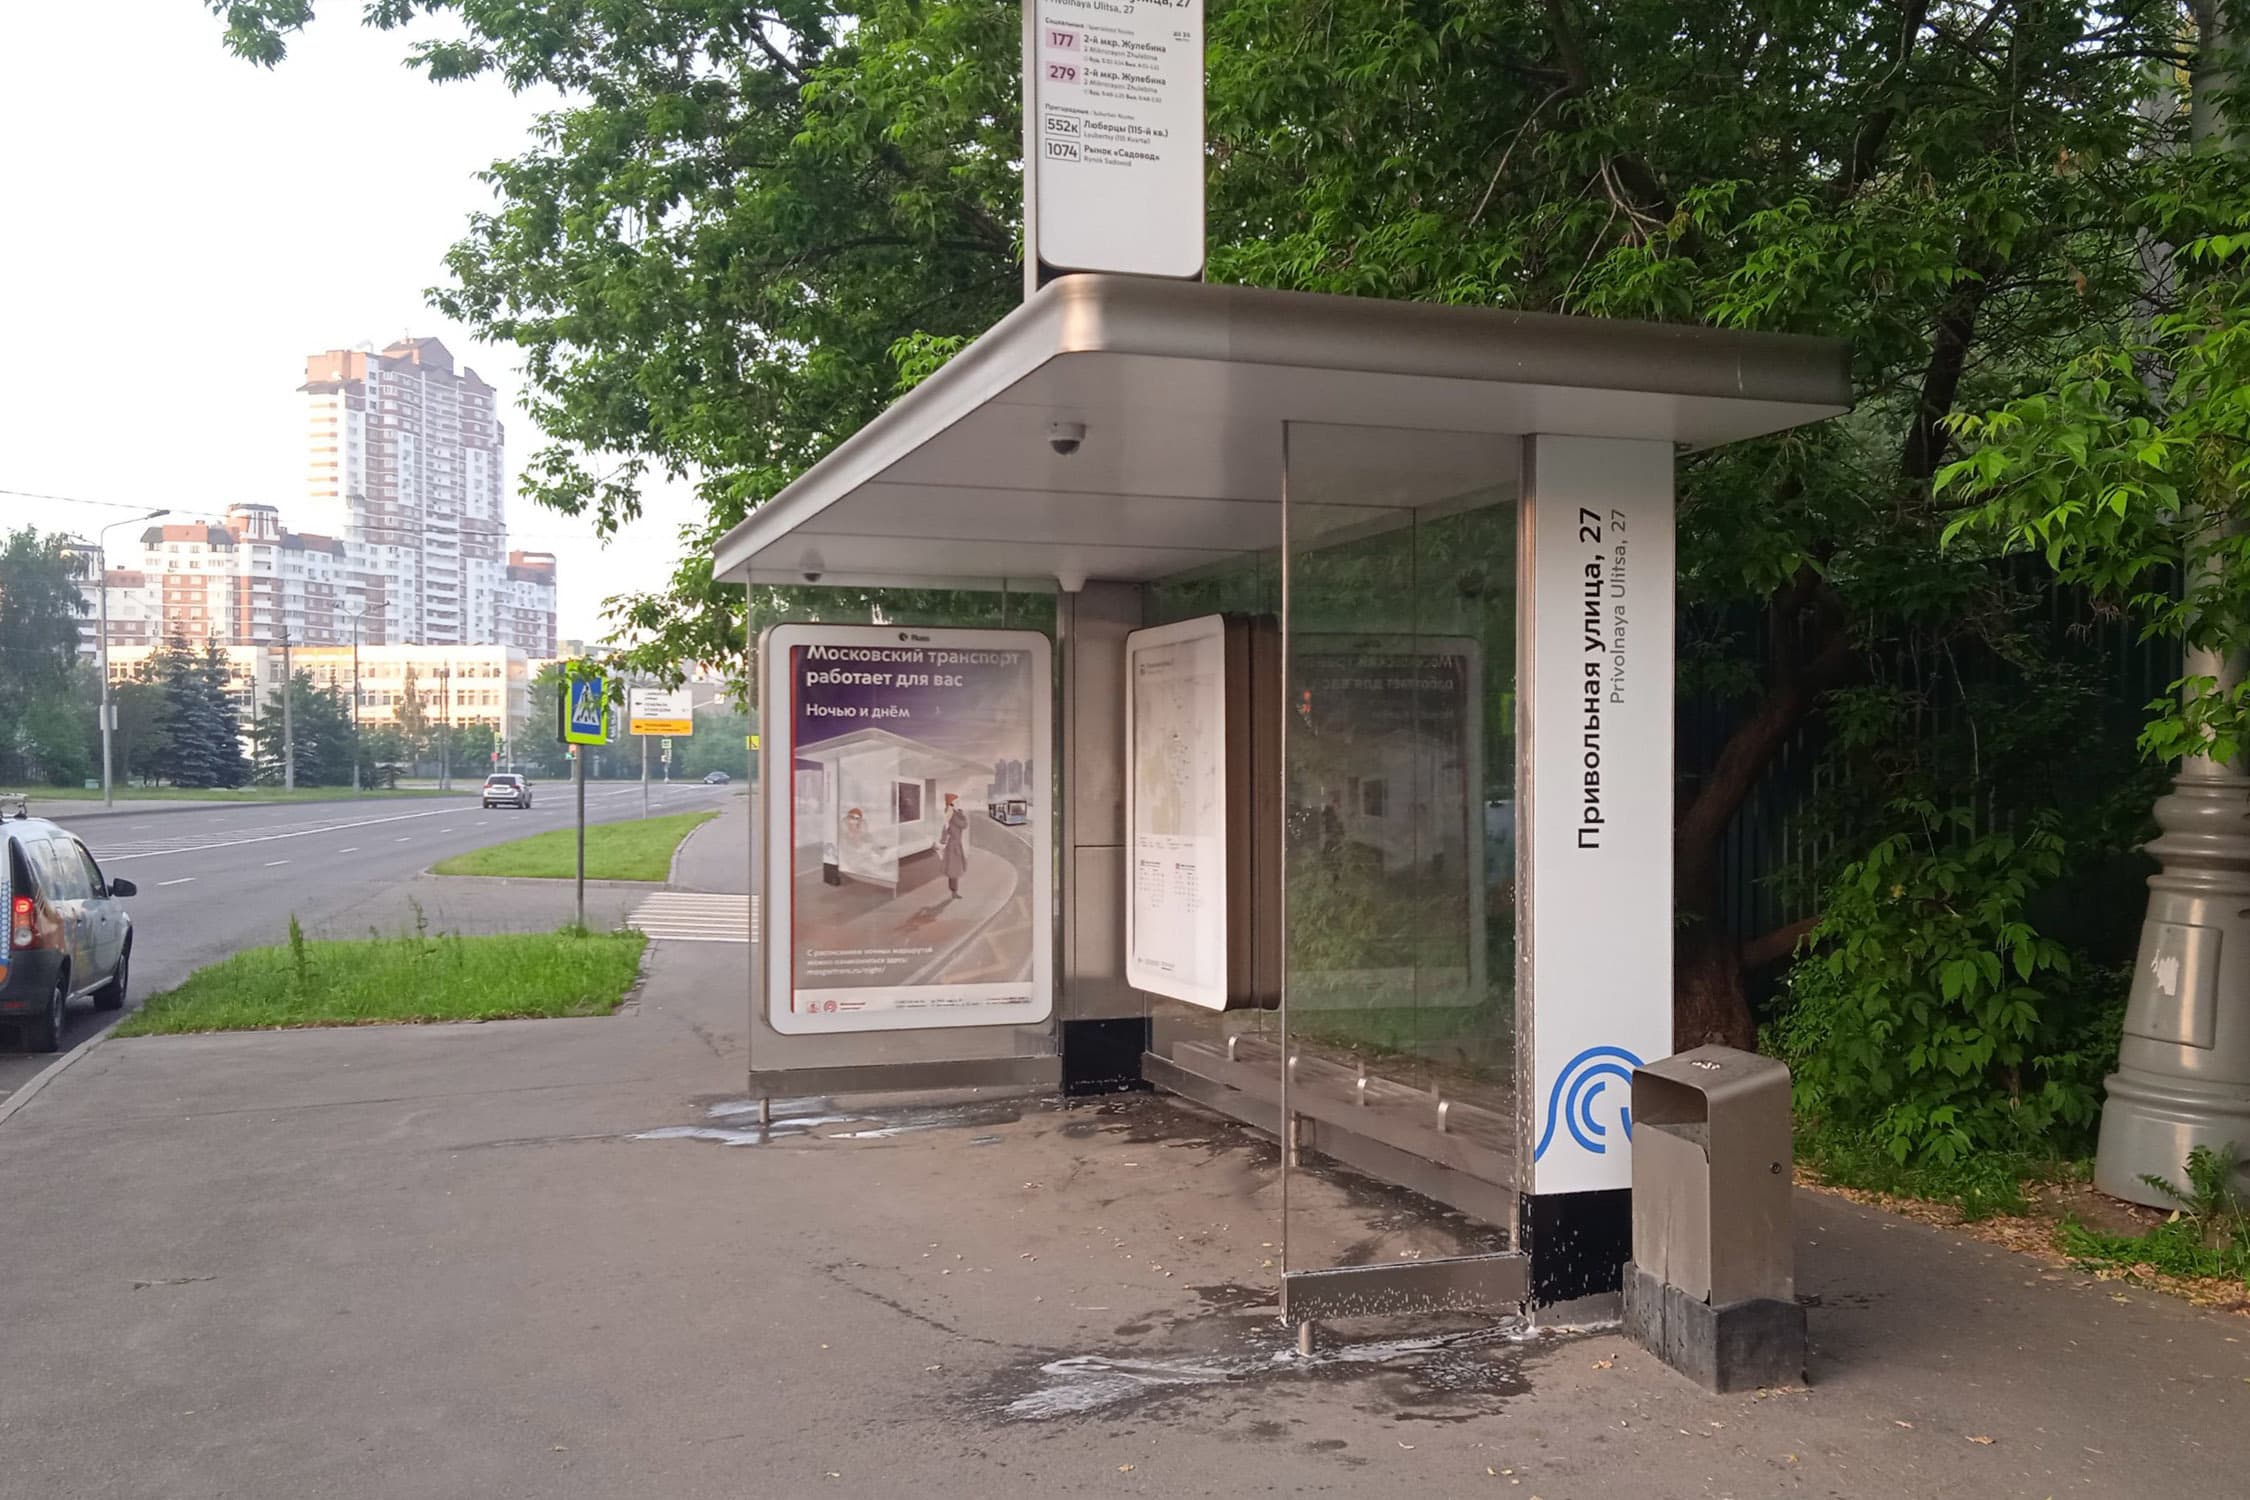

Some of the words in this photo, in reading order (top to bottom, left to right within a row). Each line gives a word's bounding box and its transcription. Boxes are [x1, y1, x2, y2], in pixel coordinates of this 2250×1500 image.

[1124, 5, 1134, 14] 27
[1052, 32, 1073, 47] 177
[1084, 34, 1098, 44] 2-й
[1100, 38, 1120, 48] мкр.
[1121, 40, 1166, 53] Жулебина
[1050, 65, 1076, 80] 279
[1084, 67, 1098, 77] 2-й
[1100, 72, 1120, 80] мкр.
[1121, 72, 1166, 85] Жулебина
[1047, 118, 1078, 133] 552к
[1084, 120, 1126, 132] Люберцы
[1127, 125, 1152, 136] (115-й
[1153, 129, 1168, 137] кв.)
[1048, 142, 1077, 158] 1074
[1084, 145, 1112, 155] Рынок
[1579, 507, 1601, 543] 27
[1611, 509, 1626, 532] 27
[1610, 540, 1628, 599] Ulitsa,
[1584, 554, 1605, 653] улица,
[807, 645, 924, 663] Московский
[928, 649, 1020, 666] транспорт
[1610, 605, 1629, 704] Privolnaya
[807, 669, 893, 687] работает
[896, 674, 929, 688] для
[934, 674, 964, 687] вас
[806, 704, 857, 717] Ночью
[860, 707, 869, 717] и
[871, 705, 910, 718] днём
[1578, 661, 1605, 849] Привольная
